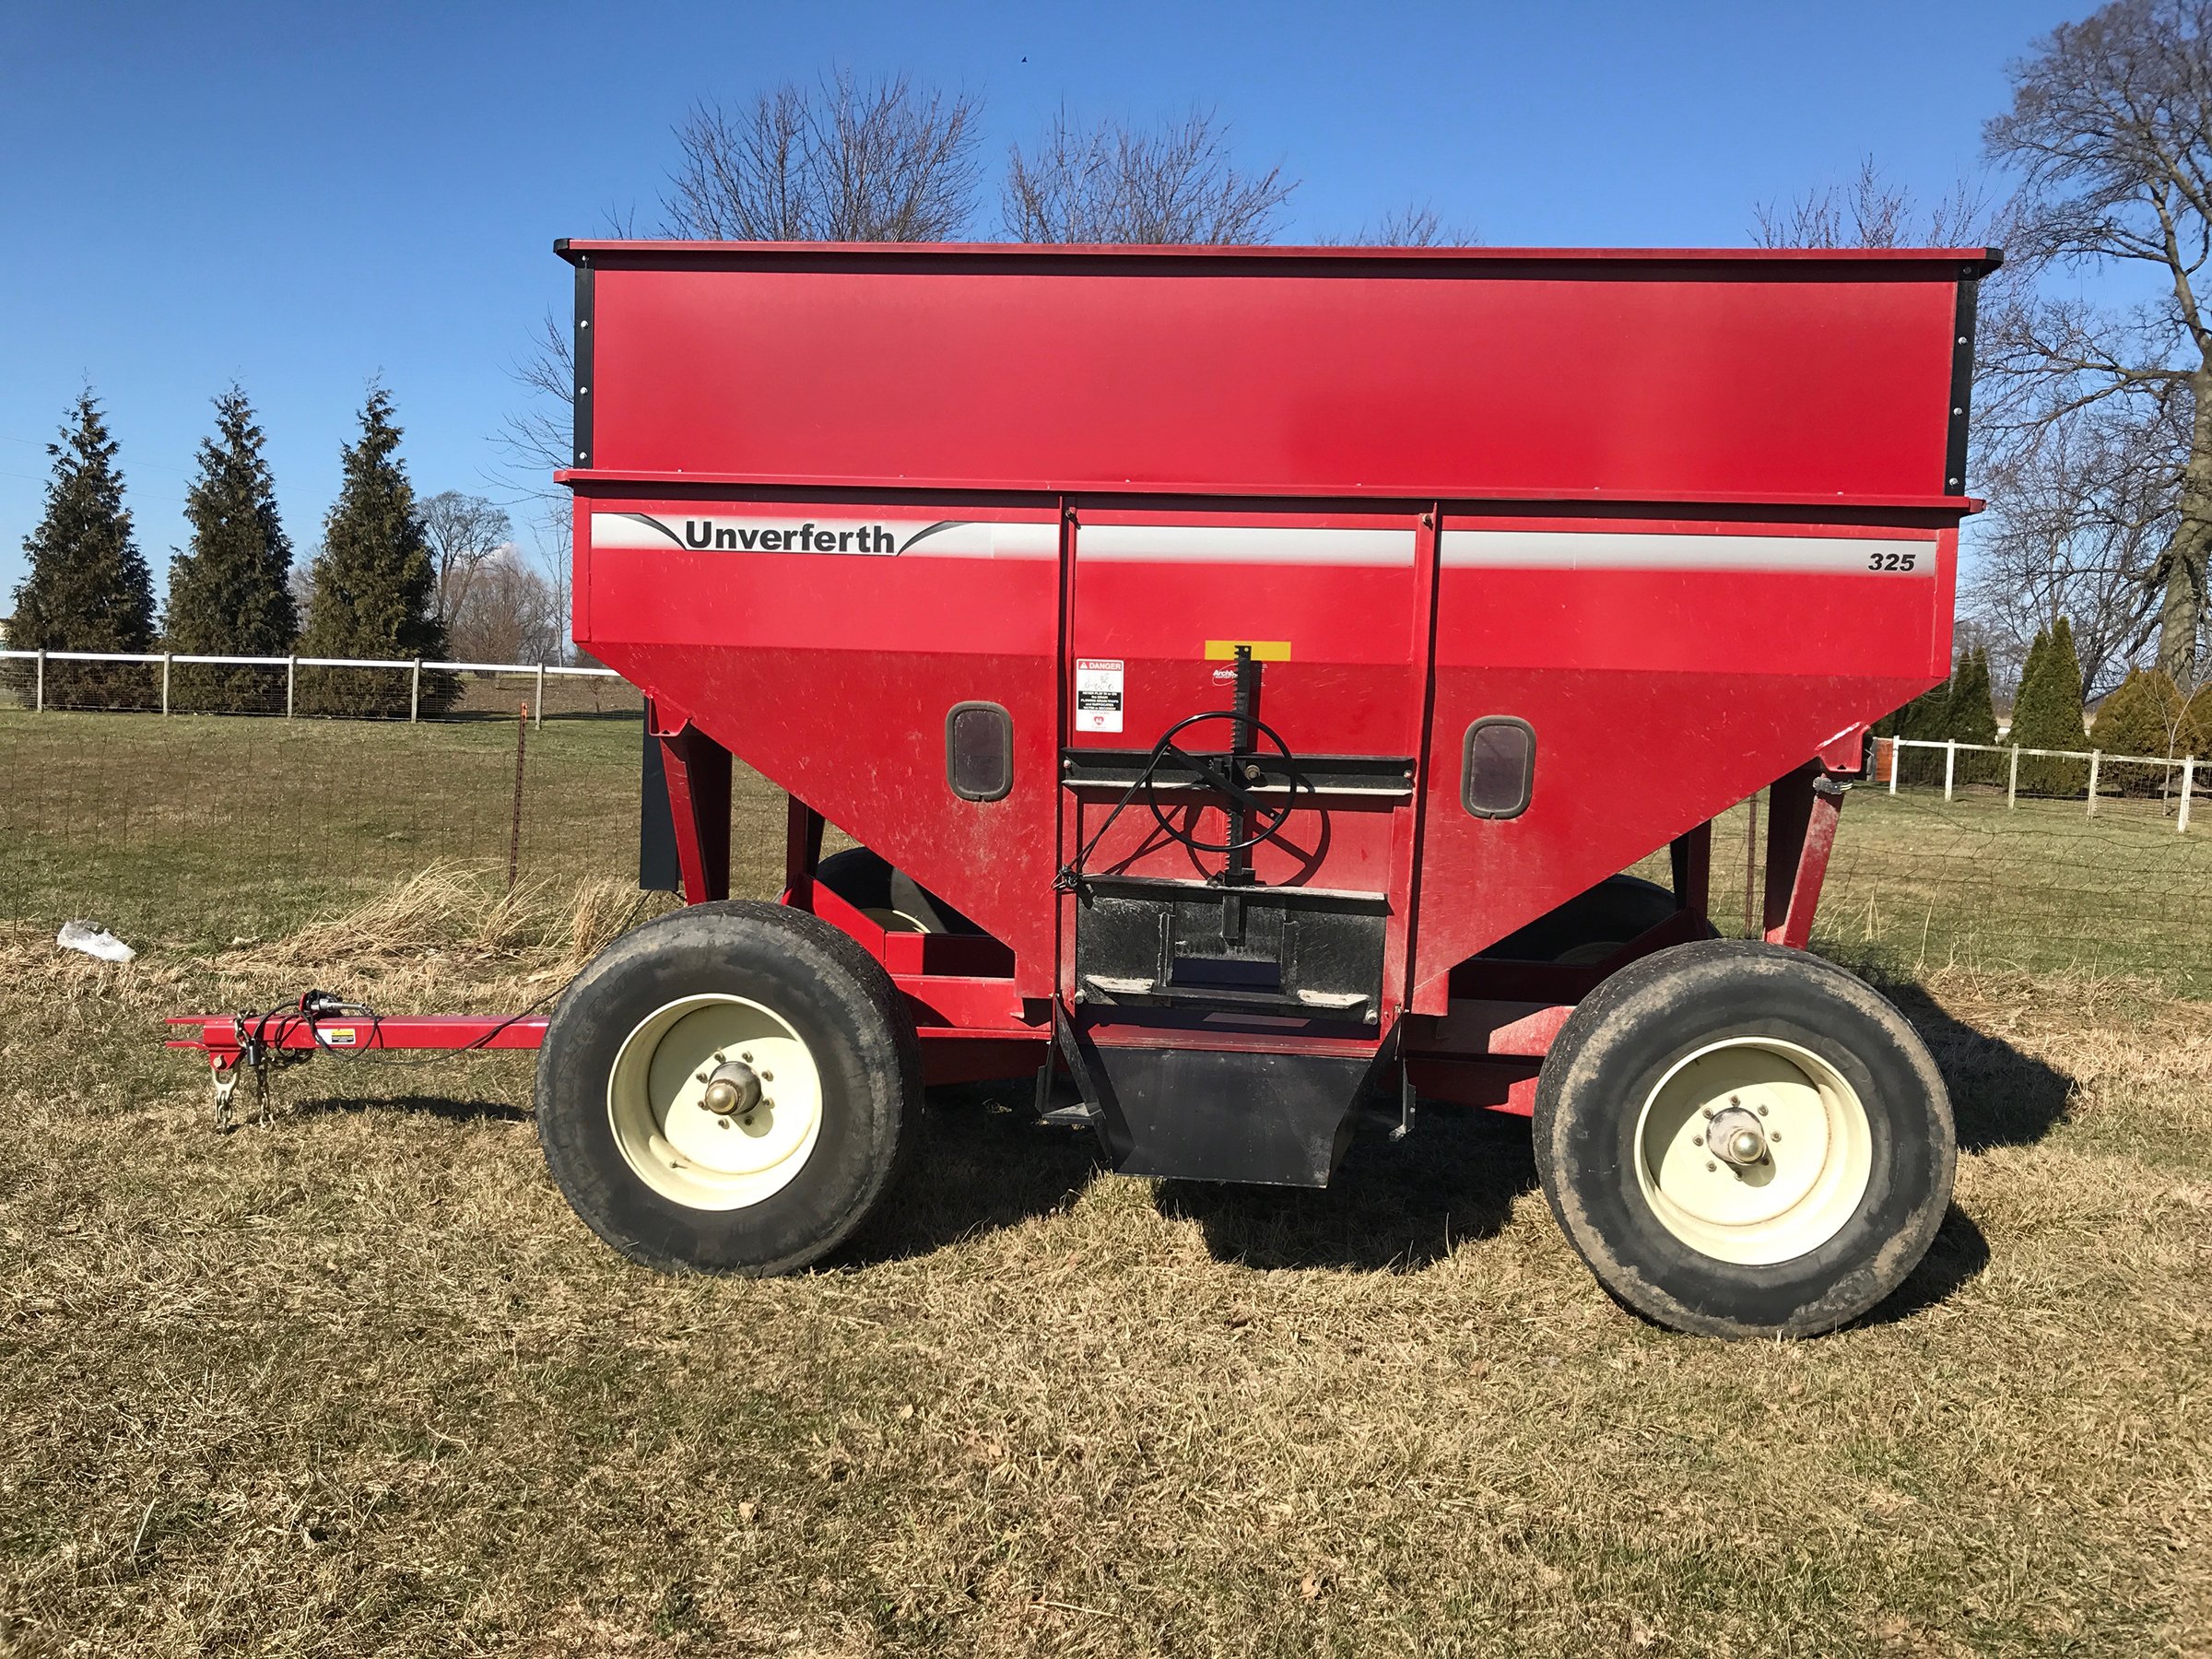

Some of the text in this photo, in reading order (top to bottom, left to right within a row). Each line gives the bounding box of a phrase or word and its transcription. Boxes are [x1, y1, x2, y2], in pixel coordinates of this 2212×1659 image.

[686, 521, 895, 553] Unverferth
[1868, 553, 1916, 571] 325
[1089, 662, 1122, 670] DANGER
